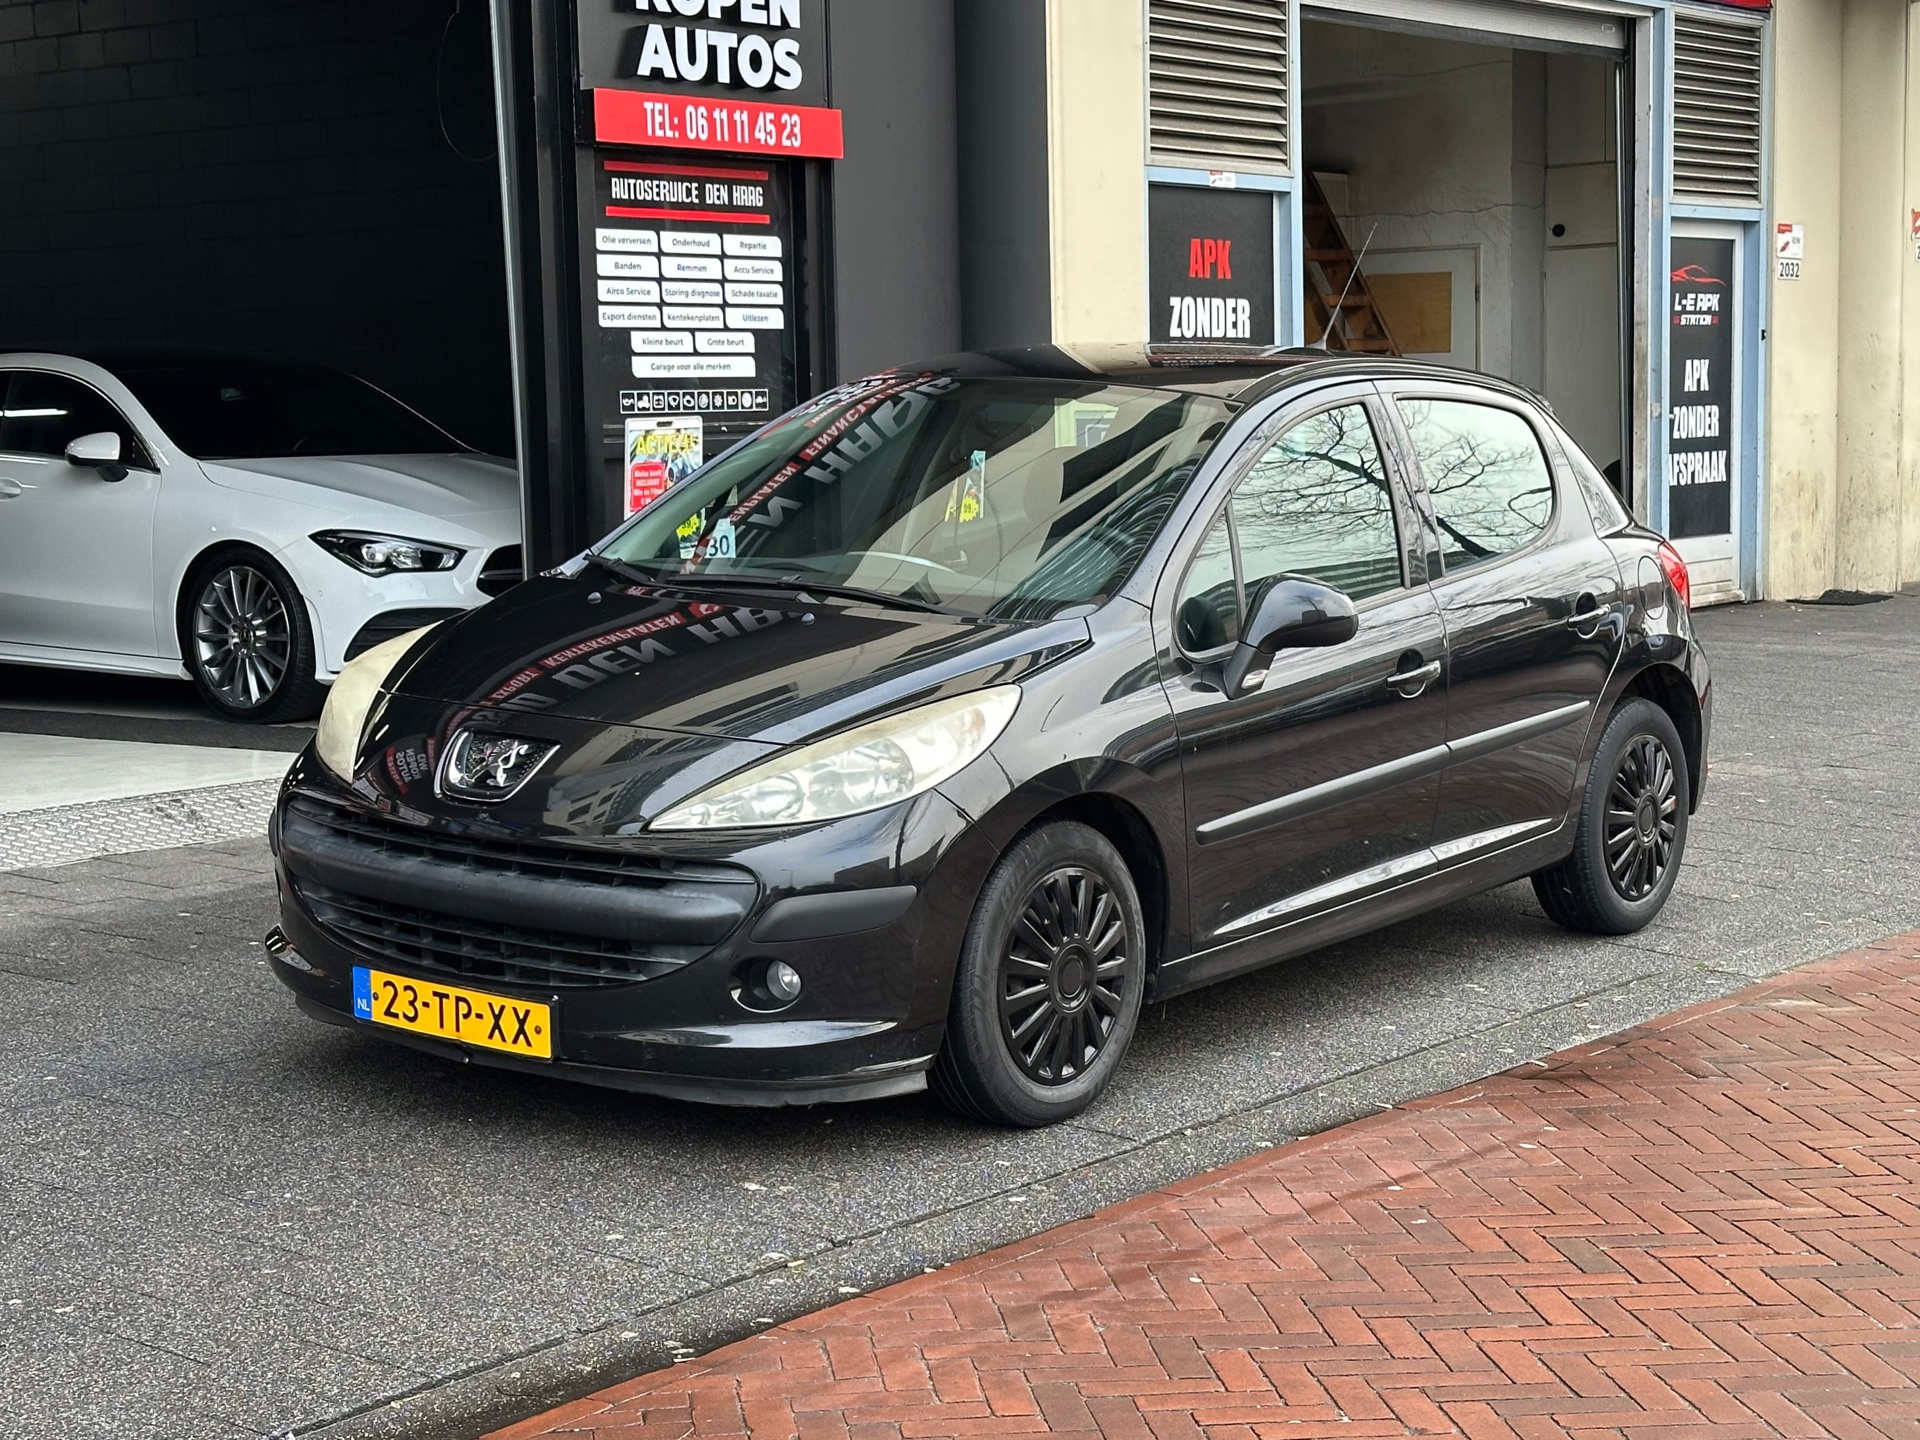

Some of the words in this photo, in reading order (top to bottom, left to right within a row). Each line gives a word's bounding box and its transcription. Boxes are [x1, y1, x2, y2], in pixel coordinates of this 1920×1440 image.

[636, 23, 803, 90] AUTOS
[643, 101, 679, 138] TEL:
[685, 105, 708, 141] 06
[713, 107, 729, 142] 11
[733, 109, 749, 144] 11
[754, 111, 776, 147] 45
[781, 113, 801, 148] 23
[611, 177, 699, 203] AUTOSERVICE
[705, 183, 729, 205] DEN
[732, 185, 764, 207] HAAG
[602, 235, 616, 245] Olie
[617, 237, 652, 245] verversen
[672, 238, 710, 248] Onderhoud
[740, 241, 767, 251] Repartie
[1189, 238, 1232, 279] APK
[614, 261, 642, 271] Banden
[677, 263, 707, 273] Remmen
[733, 265, 750, 274] Accu
[751, 266, 774, 275] Service
[1779, 262, 1800, 279] 2032
[606, 286, 625, 296] Airco
[626, 287, 651, 296] Service
[665, 288, 689, 299] Storing
[691, 288, 720, 299] diagnose
[731, 289, 755, 298] Schade
[756, 290, 778, 298] taxatie
[1696, 293, 1720, 311] APK
[602, 312, 625, 322] Export
[627, 312, 657, 321] diensten
[667, 313, 720, 323] Kentekenplaten
[742, 314, 769, 322] Uitlezen
[1169, 296, 1251, 339] ZONDER
[1680, 314, 1712, 326] STATION
[642, 338, 663, 346] Kleine
[665, 338, 684, 346] beurt
[707, 338, 725, 346] Grote
[726, 338, 745, 346] beurt
[650, 363, 675, 372] Garage
[692, 363, 705, 371] alle
[706, 363, 731, 371] merken
[1684, 359, 1709, 392] APK
[1673, 405, 1719, 439] ZONDER
[708, 534, 730, 557] 30
[357, 998, 371, 1012] NL
[382, 979, 533, 1048] 23-TP-XX
